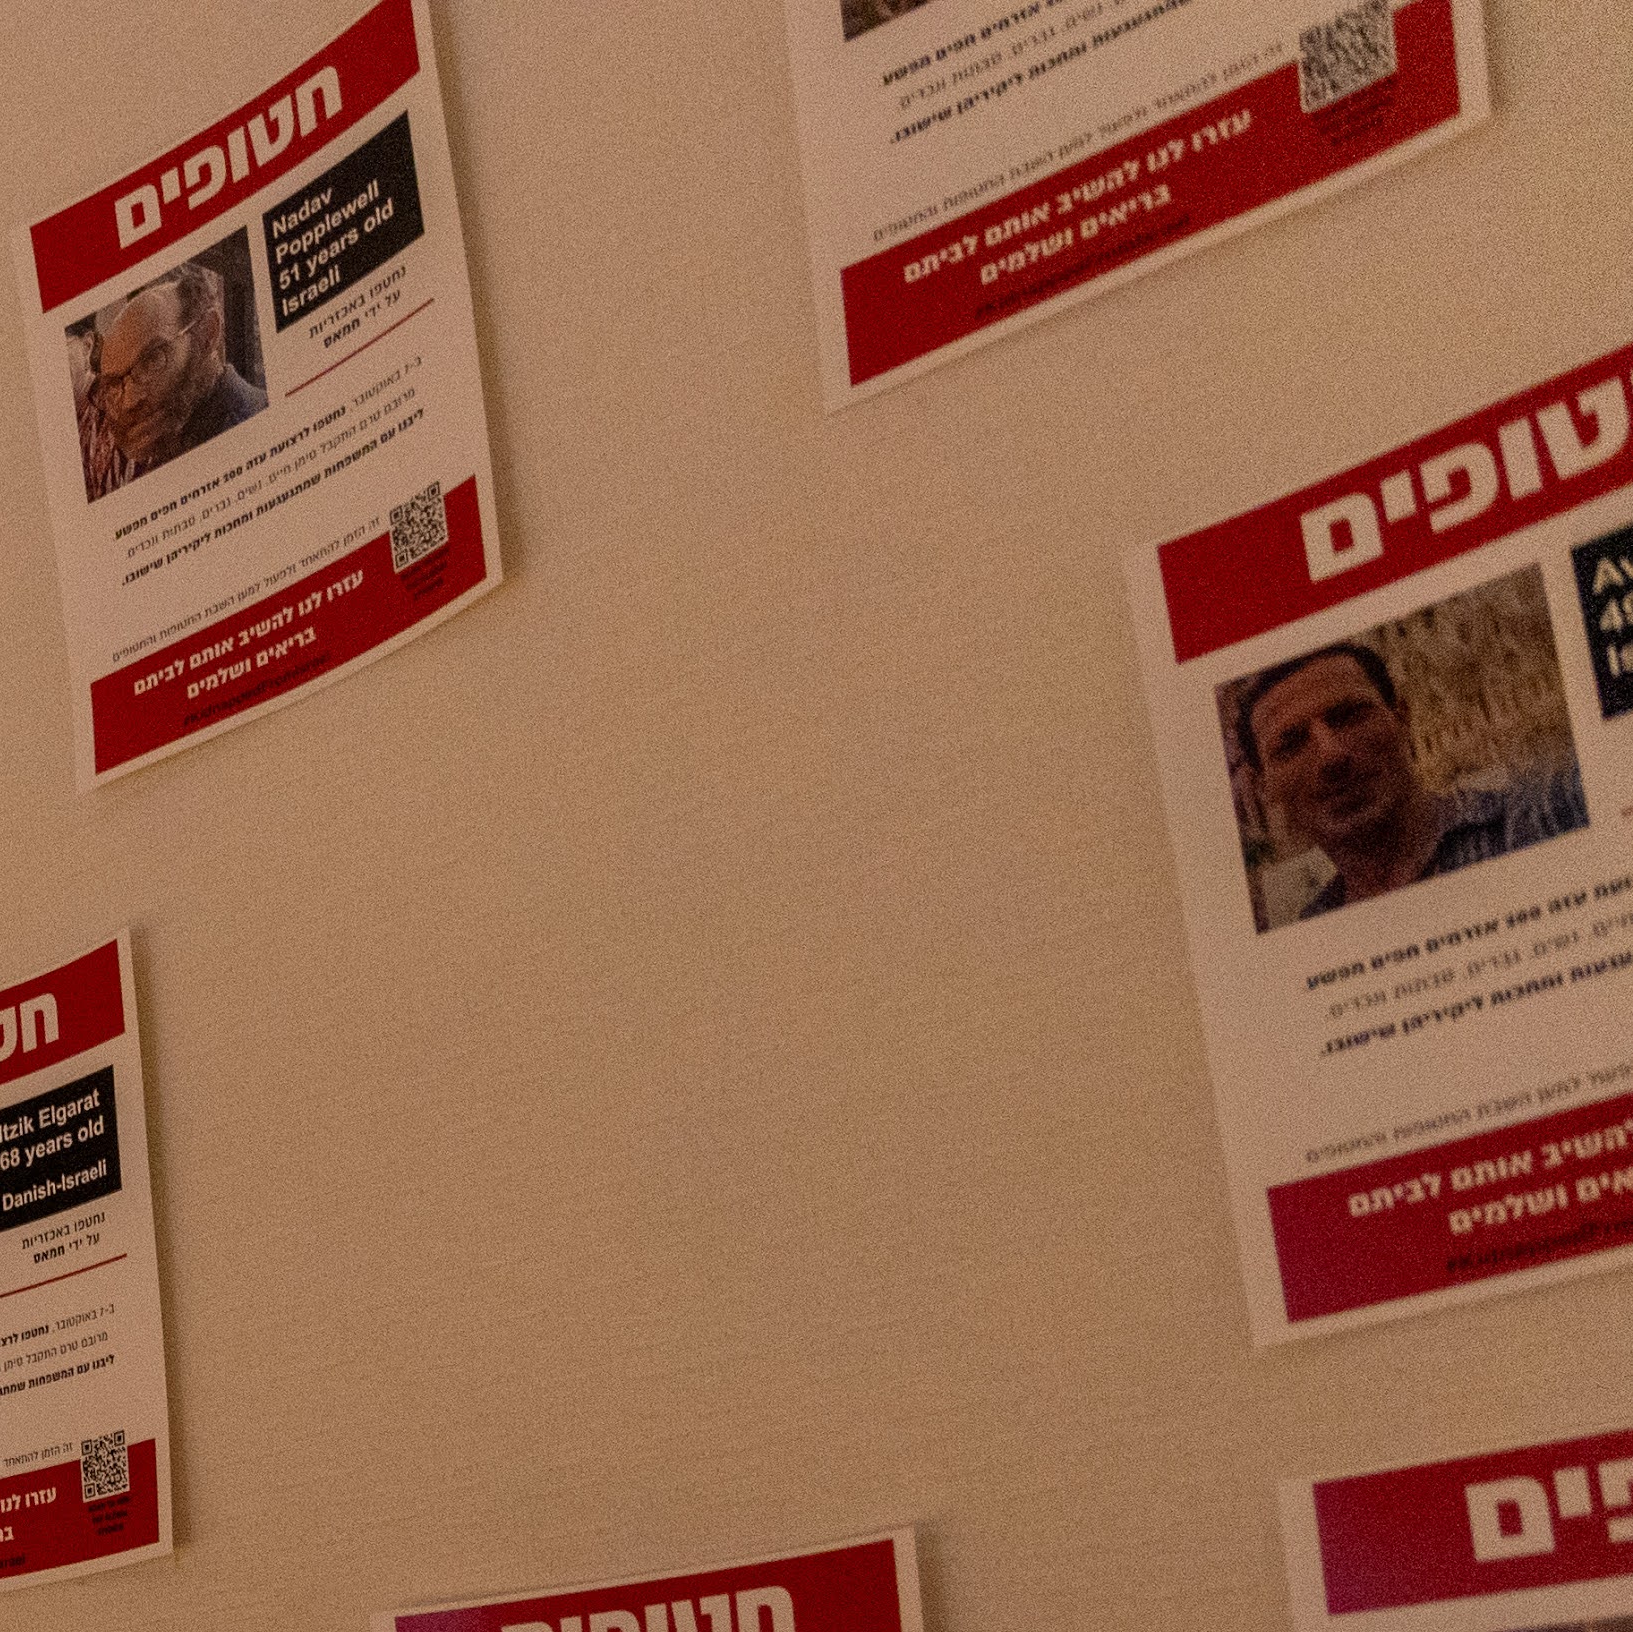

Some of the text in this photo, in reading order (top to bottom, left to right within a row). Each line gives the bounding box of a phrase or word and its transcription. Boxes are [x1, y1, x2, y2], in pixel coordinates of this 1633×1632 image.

[114, 65, 343, 250] חטופים
[271, 187, 332, 238] Nadav
[274, 178, 379, 264] Popplewell
[903, 109, 1252, 285] עזרו לנו להשיב אותם לביתם
[278, 196, 394, 290] 51 years old
[978, 183, 1173, 286] בריאים ושלמים
[281, 263, 341, 316] Israeli
[1299, 368, 1633, 585] טופים
[133, 569, 363, 695] עזרו לנו להשיב אותם לביתם
[186, 626, 316, 699] בריאים ושלמים
[37, 1088, 100, 1128] Elgarat
[23, 1131, 73, 1167] years
[76, 1114, 104, 1142] old
[1, 1158, 107, 1211] Danish-Israeli
[1347, 1170, 1442, 1218] לביתם
[1450, 1147, 1534, 1193] אותם
[1447, 1184, 1569, 1236] ושלמים
[0, 1493, 21, 1513] לנו
[24, 1486, 57, 1507] עזרו
